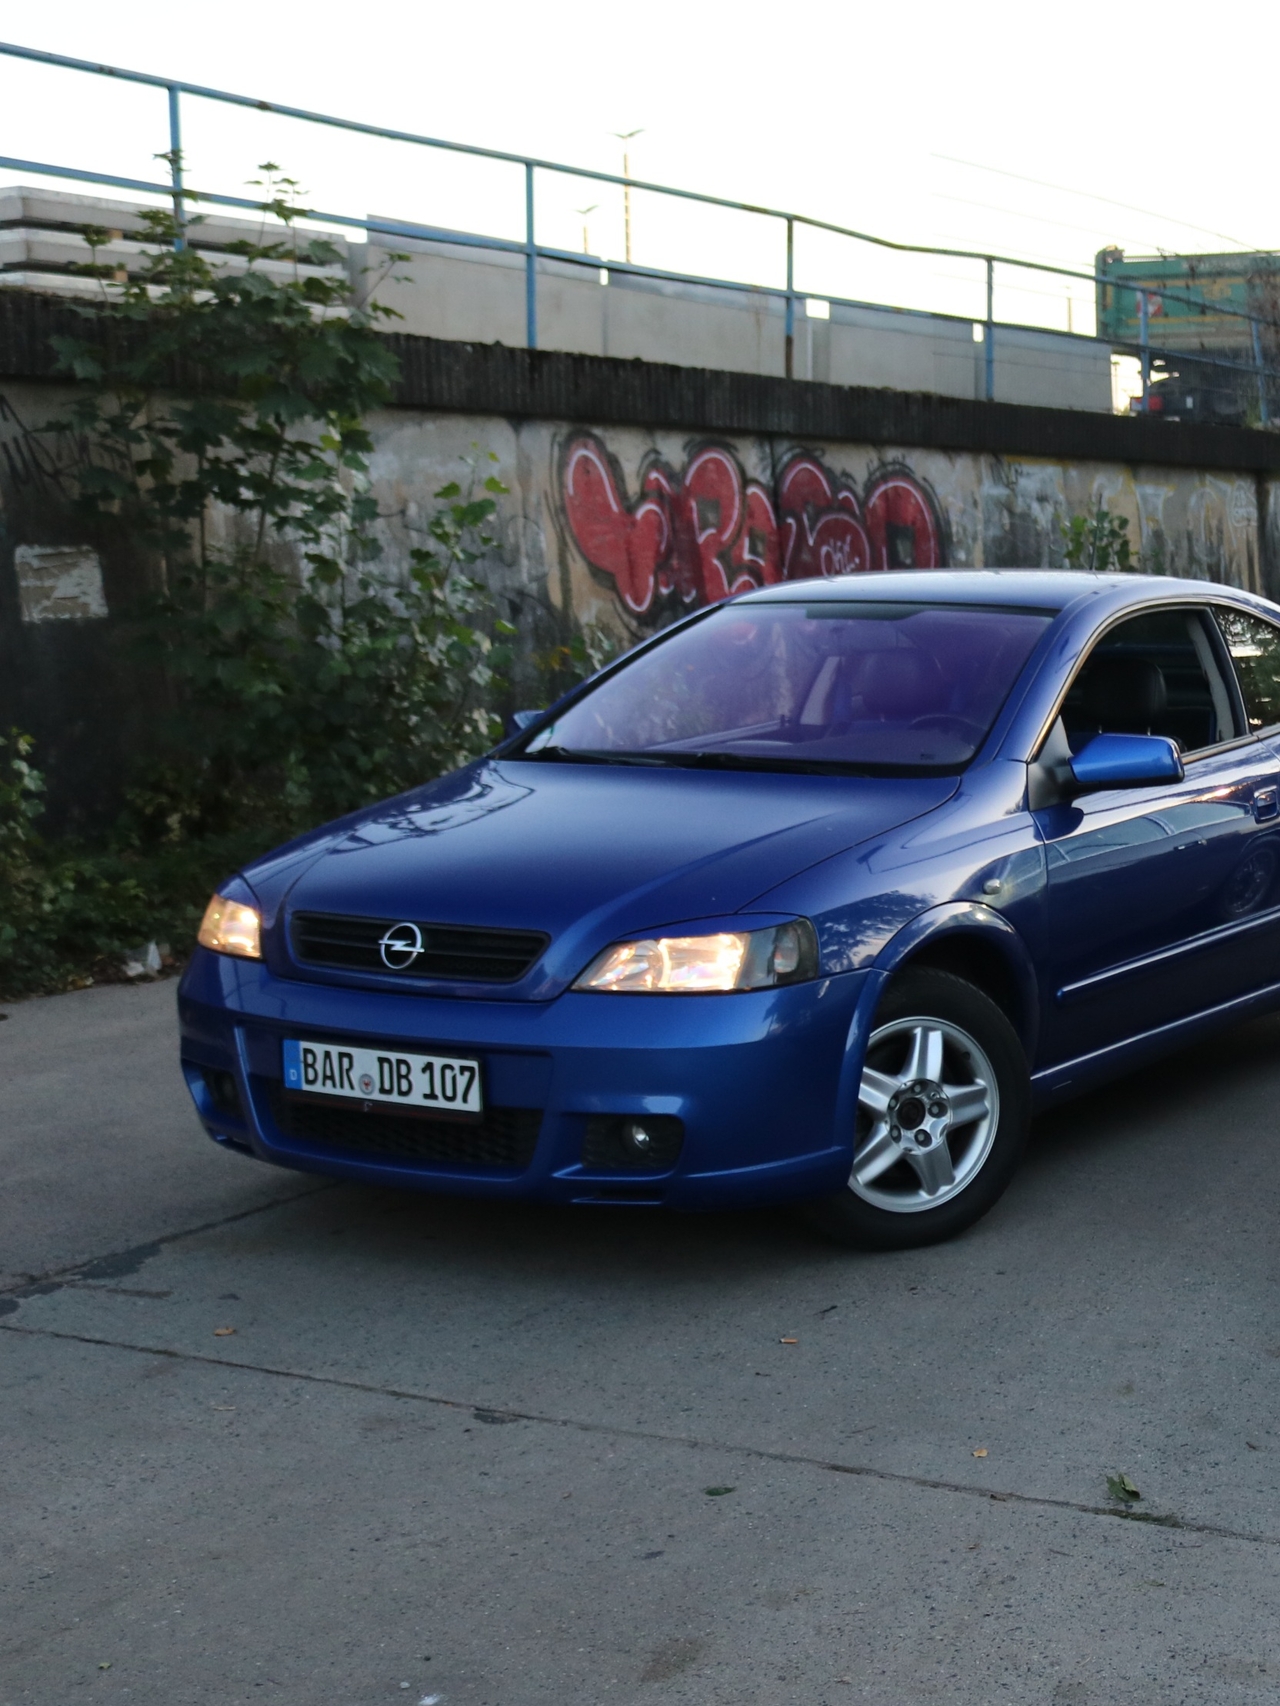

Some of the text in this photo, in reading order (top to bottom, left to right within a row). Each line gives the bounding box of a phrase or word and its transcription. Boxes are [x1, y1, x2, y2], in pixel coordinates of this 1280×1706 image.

[290, 1069, 298, 1081] D
[303, 1047, 476, 1104] BAR DB 107
